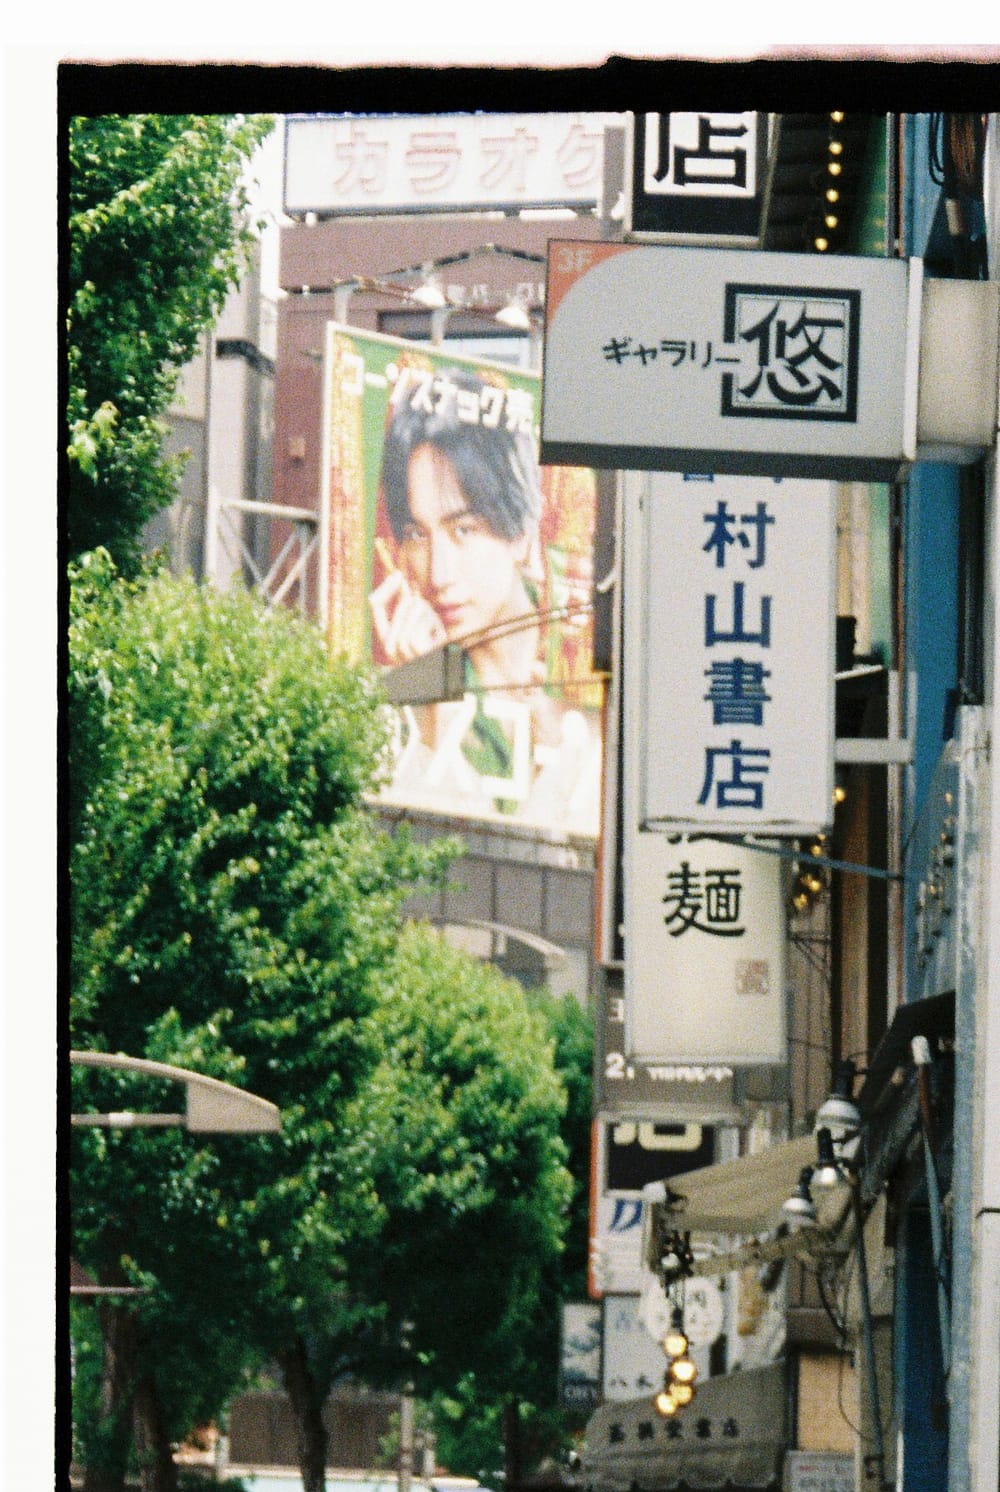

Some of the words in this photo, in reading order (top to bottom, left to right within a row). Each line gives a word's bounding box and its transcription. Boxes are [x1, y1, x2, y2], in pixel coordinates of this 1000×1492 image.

[333, 124, 604, 195] カラオケ
[653, 112, 748, 188] 店
[698, 501, 776, 810] 村山書店
[662, 832, 748, 938] 麺
